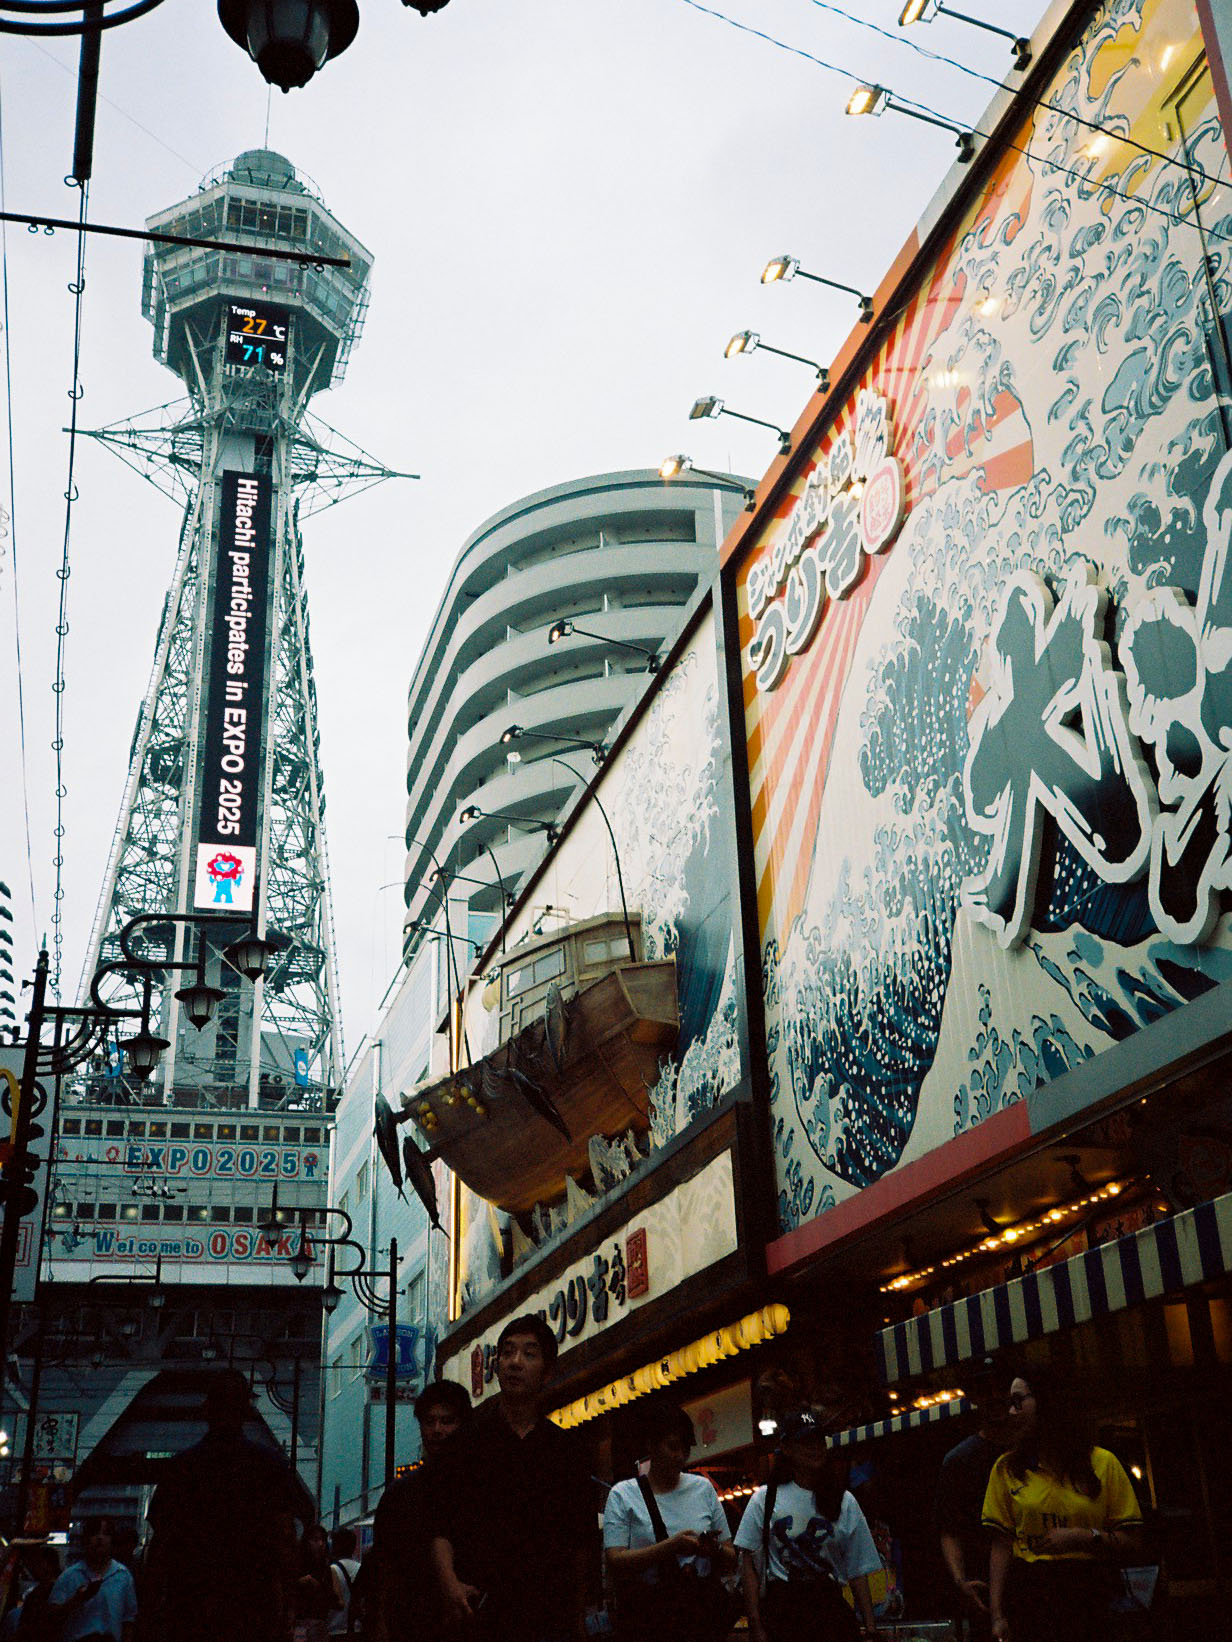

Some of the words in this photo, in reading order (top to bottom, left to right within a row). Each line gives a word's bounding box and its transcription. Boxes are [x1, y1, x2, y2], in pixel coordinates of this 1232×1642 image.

[231, 306, 256, 318] Temp
[242, 317, 267, 335] 27
[229, 335, 244, 344] RH
[242, 345, 264, 362] 71
[270, 353, 284, 366] %
[235, 477, 258, 548] Hitachi
[225, 551, 252, 675] participates
[225, 682, 248, 701] in
[220, 707, 246, 773] EXPO
[217, 778, 242, 835] 2025
[95, 1230, 181, 1255] Welcome
[186, 1240, 201, 1255] to
